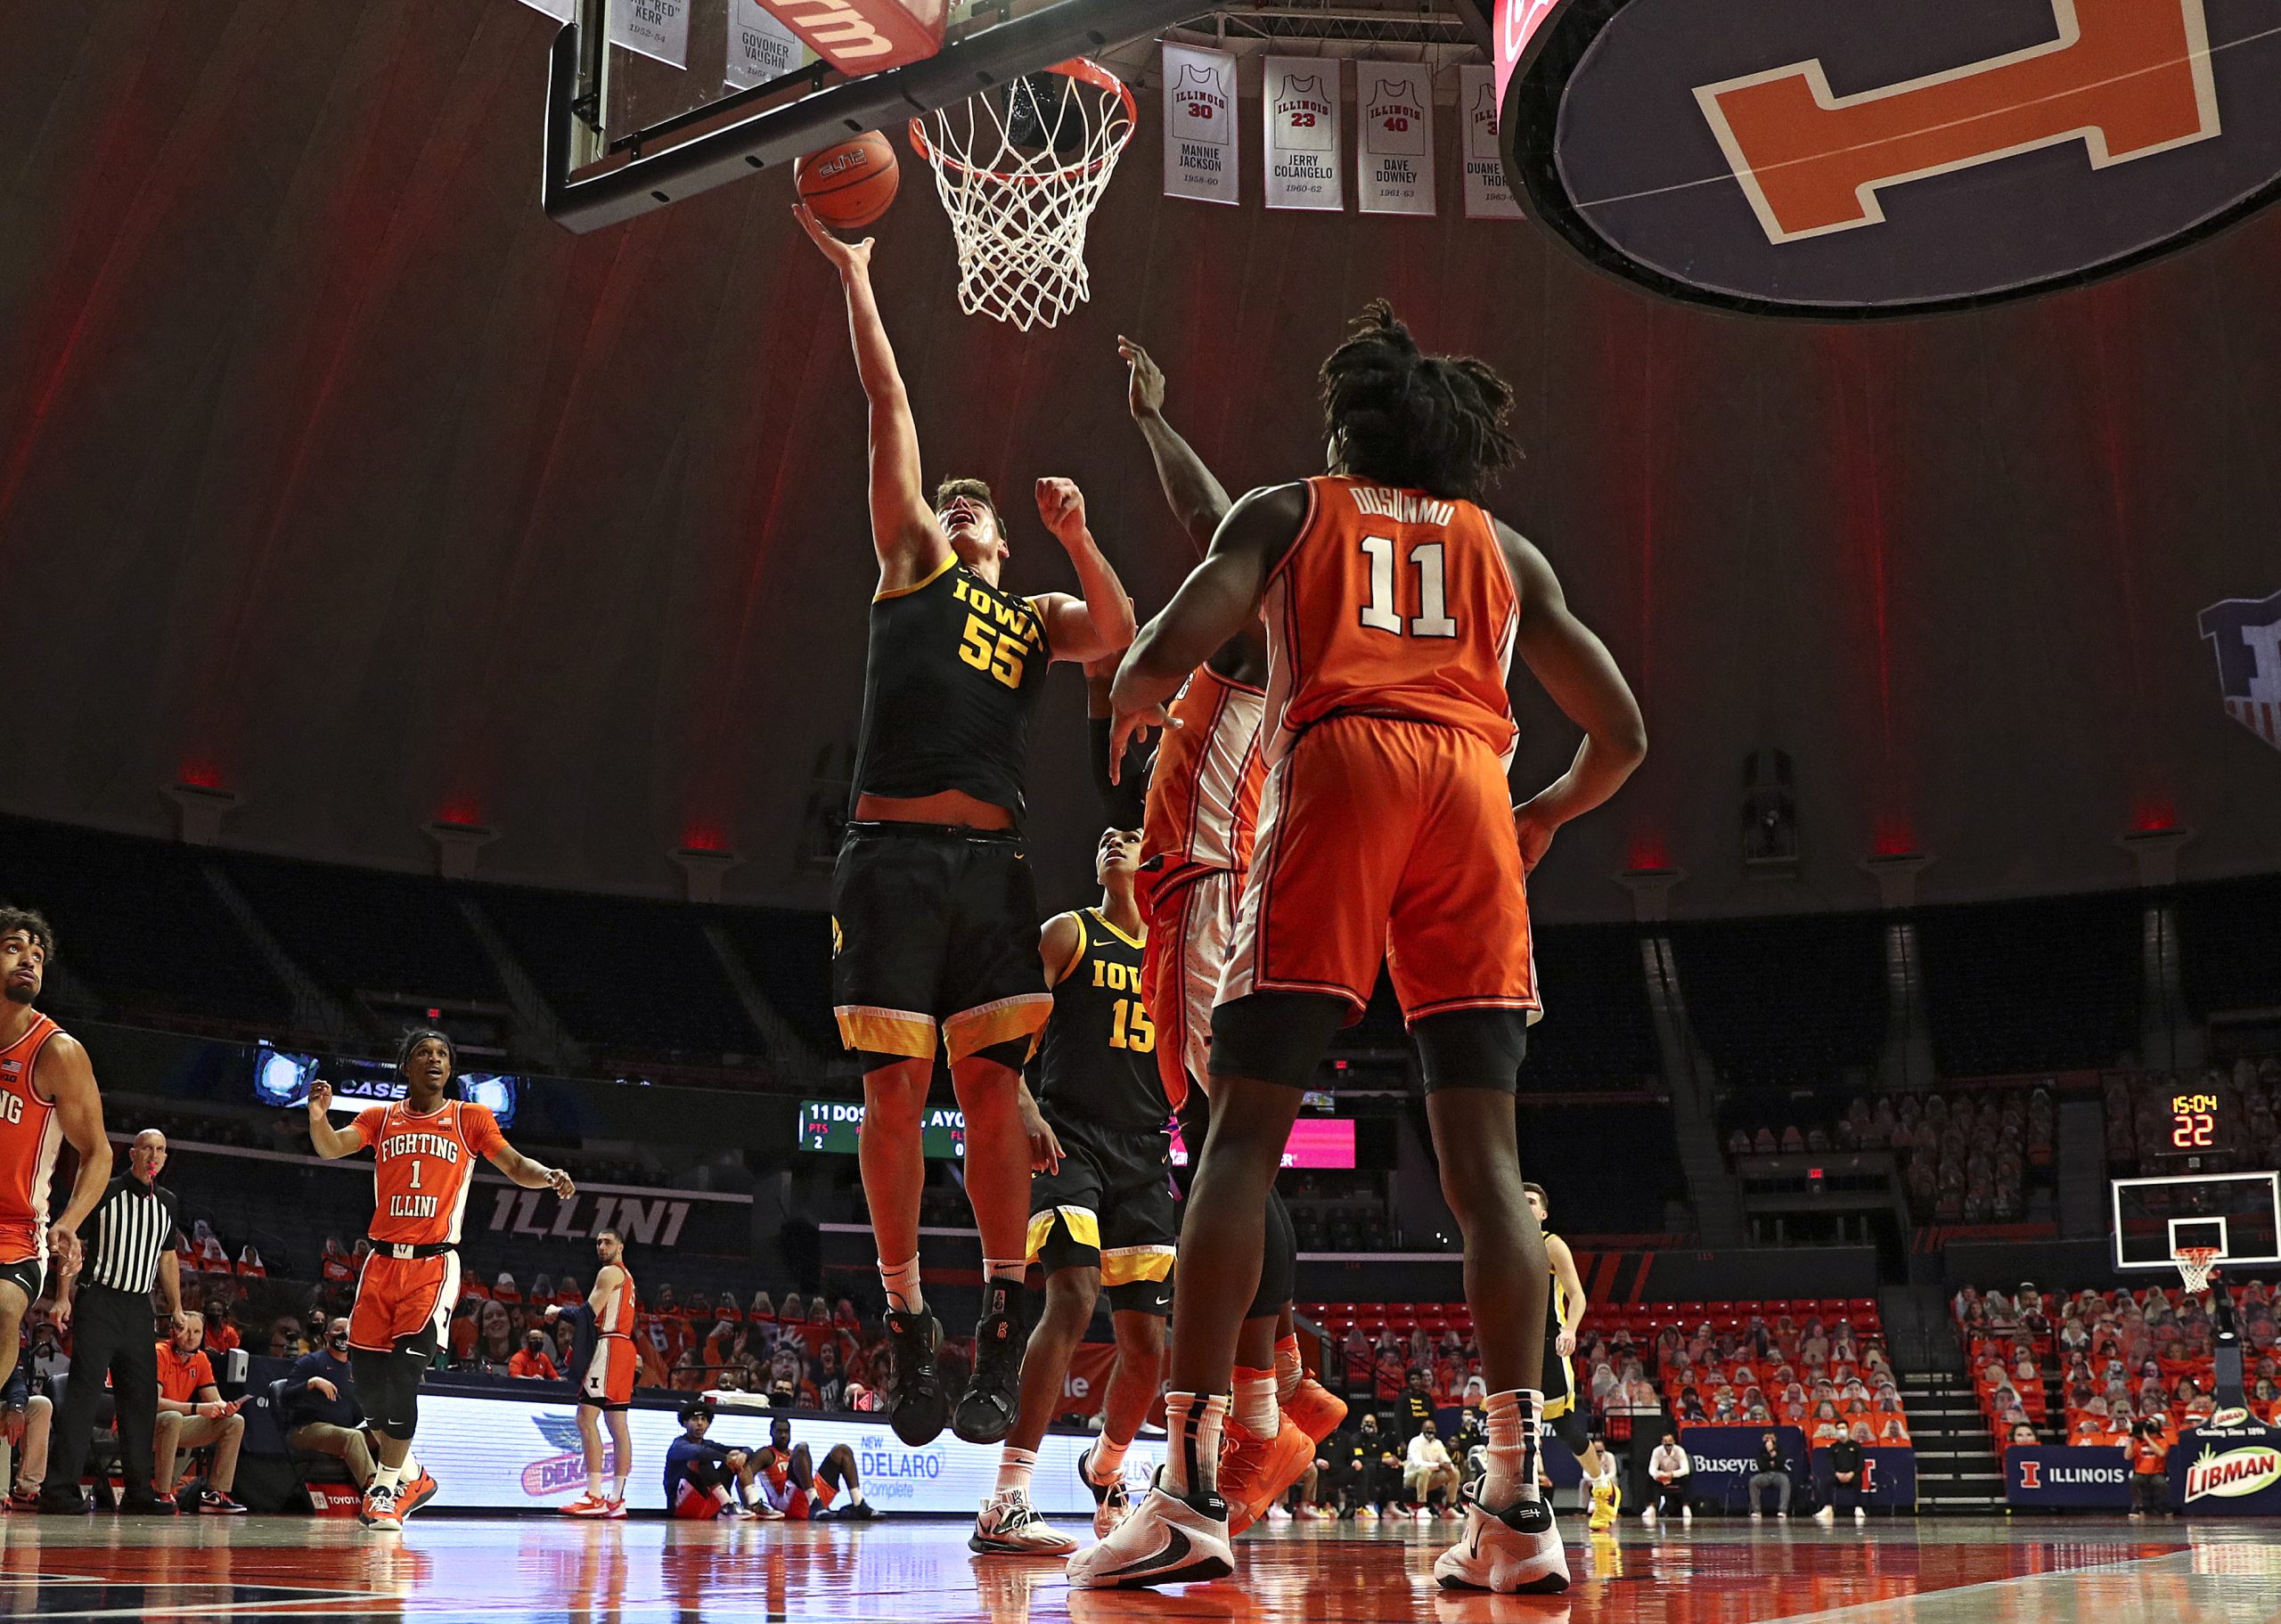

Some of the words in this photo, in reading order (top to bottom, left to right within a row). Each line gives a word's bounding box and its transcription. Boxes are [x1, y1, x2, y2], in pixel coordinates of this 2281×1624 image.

[635, 5, 661, 26] KERR
[742, 32, 789, 58] GOVONER
[745, 45, 785, 69] VAUGHN
[1176, 90, 1224, 110] ILLINOIS
[1278, 100, 1329, 116] ILLINOIS
[1188, 103, 1213, 119] 30
[1291, 113, 1315, 127] 23
[1369, 105, 1420, 120] ILLINOIS
[1383, 118, 1409, 132] 40
[1487, 121, 1498, 135] 3
[1181, 143, 1220, 160] MANNIE
[819, 148, 867, 177] ELITE
[1180, 155, 1222, 172] JACKSON
[1288, 155, 1319, 167] JERRY
[1384, 159, 1409, 171] DAVE
[1467, 162, 1500, 174] DUANE
[1274, 165, 1333, 179] COLANGELO
[1376, 170, 1417, 184] DOWNEY
[1286, 184, 1322, 193] 1960-62
[1379, 189, 1415, 198] 1961-63
[1485, 192, 1516, 200] 1963-6
[1349, 487, 1455, 526] DOSUNMU
[1359, 535, 1458, 638] 11
[958, 612, 1029, 690] 55
[1108, 998, 1156, 1053] 15
[2172, 1094, 2218, 1114] 15:04
[811, 1104, 829, 1121] 11
[833, 1105, 866, 1123] DOS
[808, 1123, 830, 1135] PTS
[2172, 1114, 2214, 1147] 22
[380, 1132, 459, 1164] FIGHTING
[813, 1136, 823, 1149] 2
[954, 1143, 965, 1157] 0
[409, 1160, 421, 1189] 1
[389, 1195, 439, 1218] ILLINI
[489, 1188, 691, 1246] ILLINI
[861, 1435, 884, 1449] NEW
[862, 1451, 940, 1479] DELARO
[1692, 1454, 1749, 1478] Busey
[2049, 1468, 2125, 1483] ILLINOIS
[2187, 1455, 2275, 1498] LIBMAN
[862, 1481, 914, 1499] Complete
[328, 1496, 362, 1505] TOYOTA
